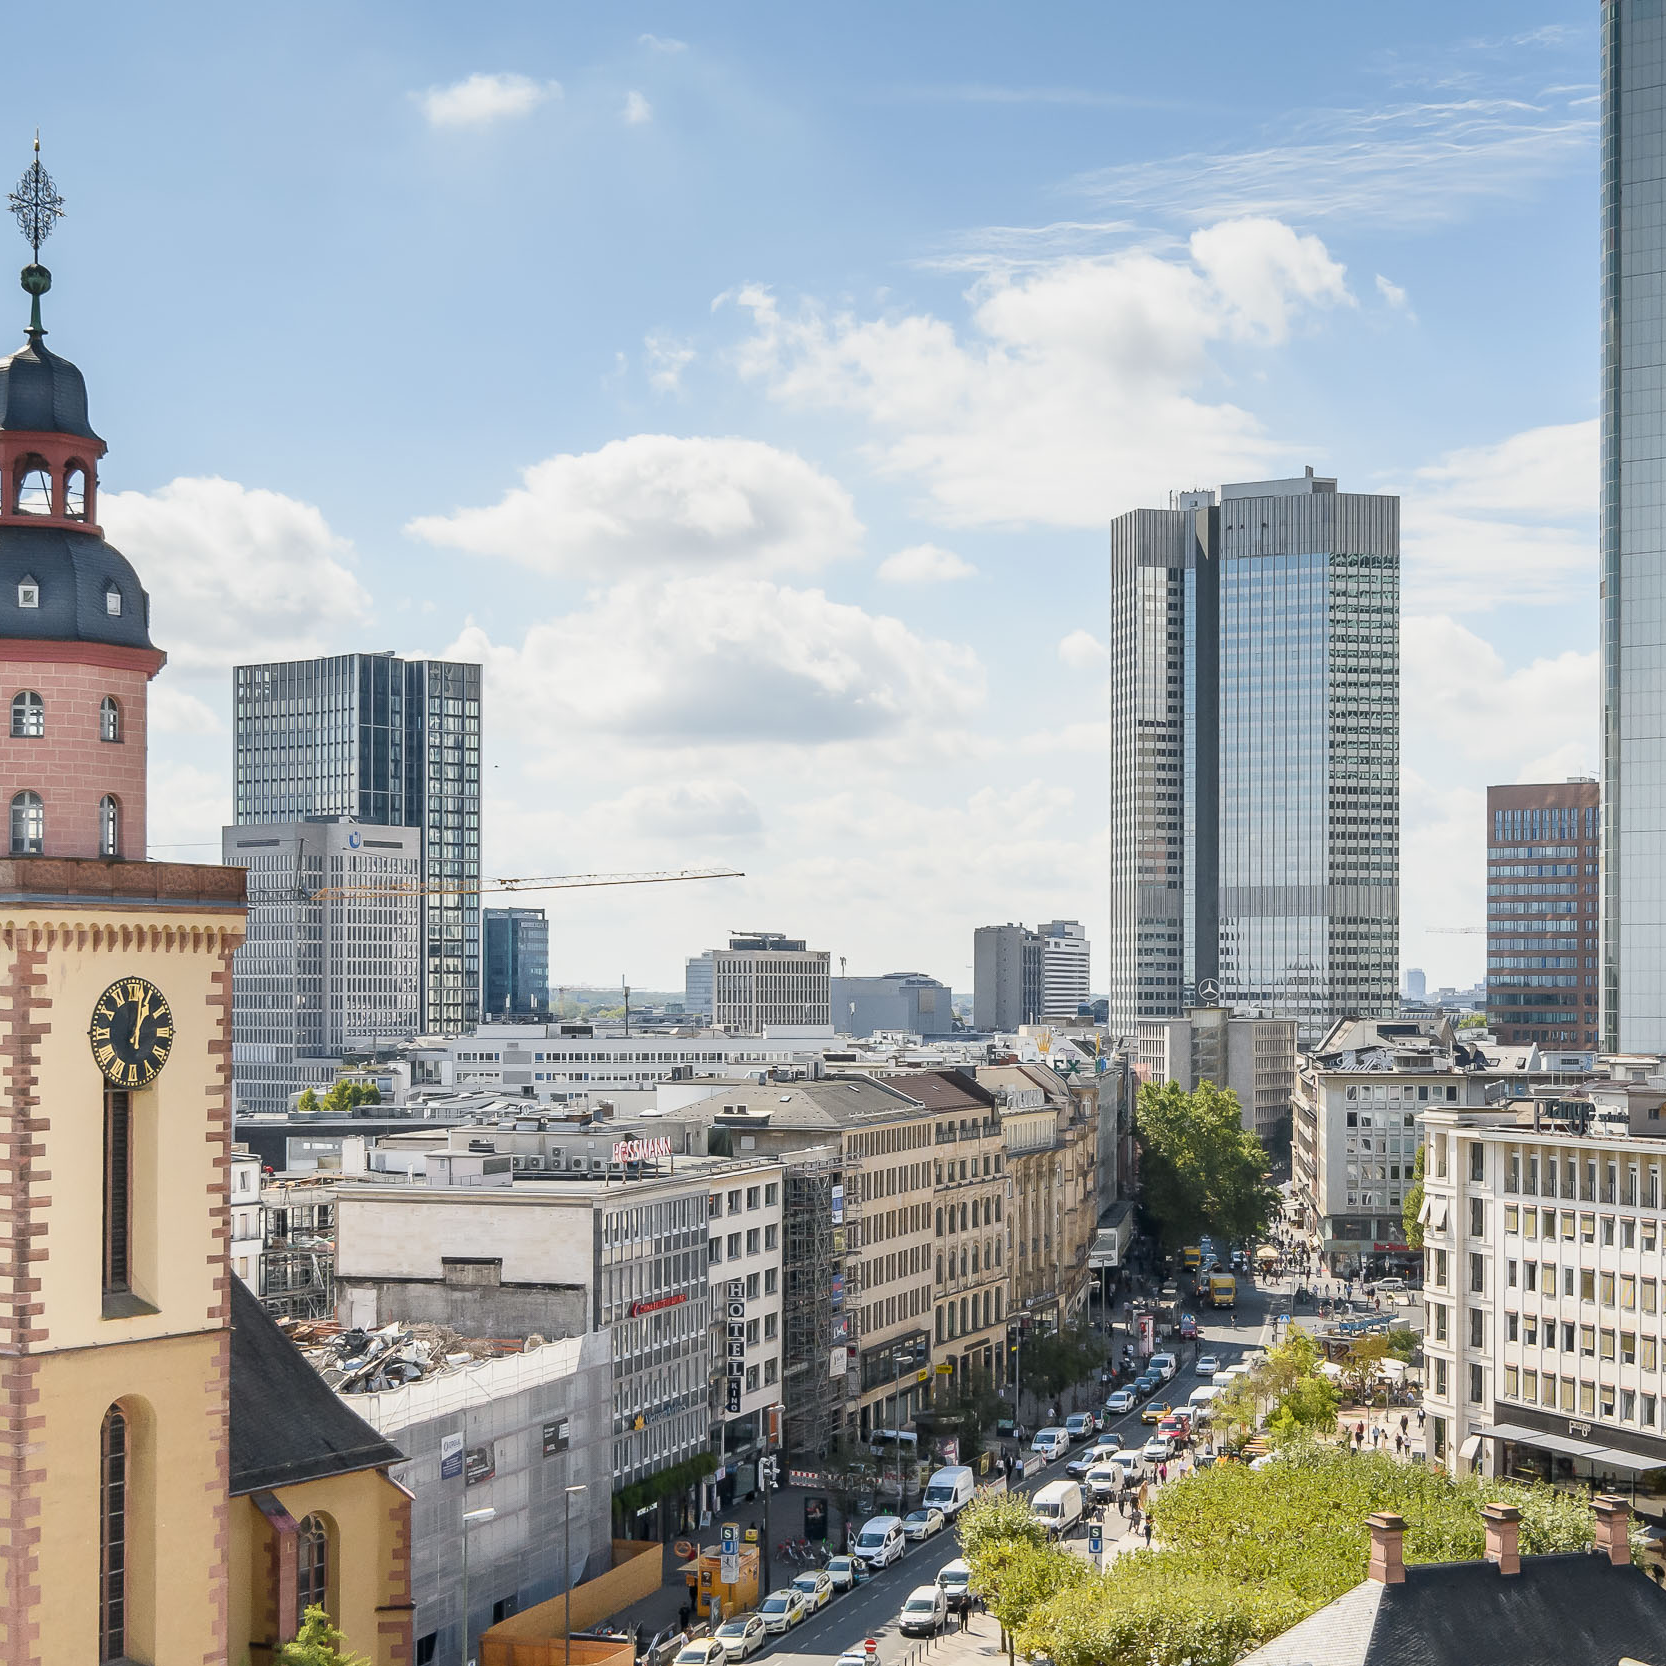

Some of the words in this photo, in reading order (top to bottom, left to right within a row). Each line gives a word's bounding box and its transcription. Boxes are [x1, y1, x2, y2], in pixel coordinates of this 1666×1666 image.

[1534, 1099, 1596, 1135] prange
[613, 1136, 671, 1162] ROSSMANN
[730, 1283, 743, 1376] HOTEL
